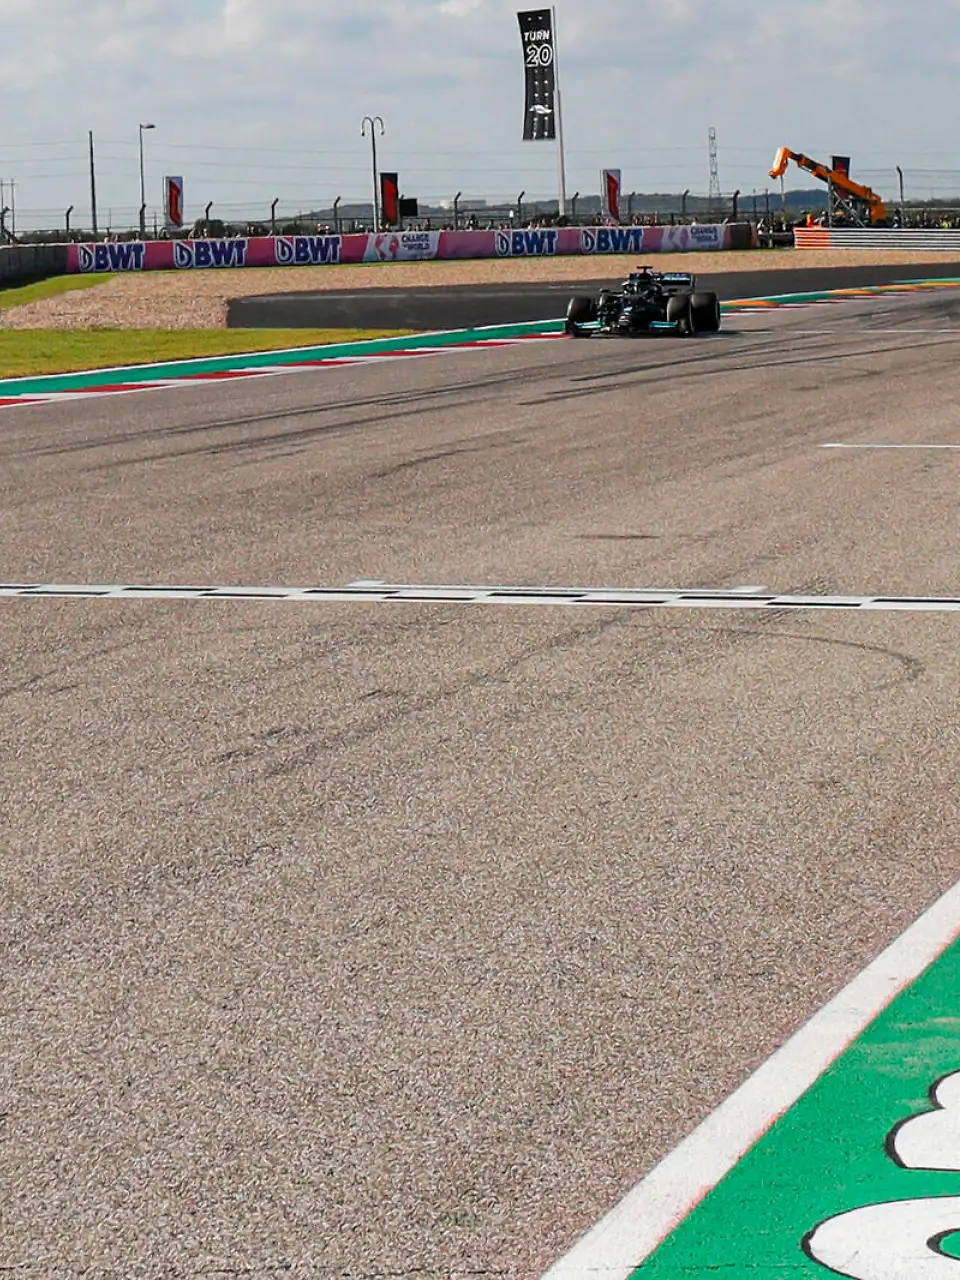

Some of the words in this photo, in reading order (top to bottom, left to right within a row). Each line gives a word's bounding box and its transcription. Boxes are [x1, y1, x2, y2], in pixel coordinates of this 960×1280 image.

[523, 30, 550, 41] TURN
[525, 43, 553, 67] 20
[194, 239, 247, 267] BWT
[294, 236, 341, 263] BWT
[512, 229, 558, 255] BWT
[597, 228, 644, 252] BWT
[94, 243, 145, 270] BWT
